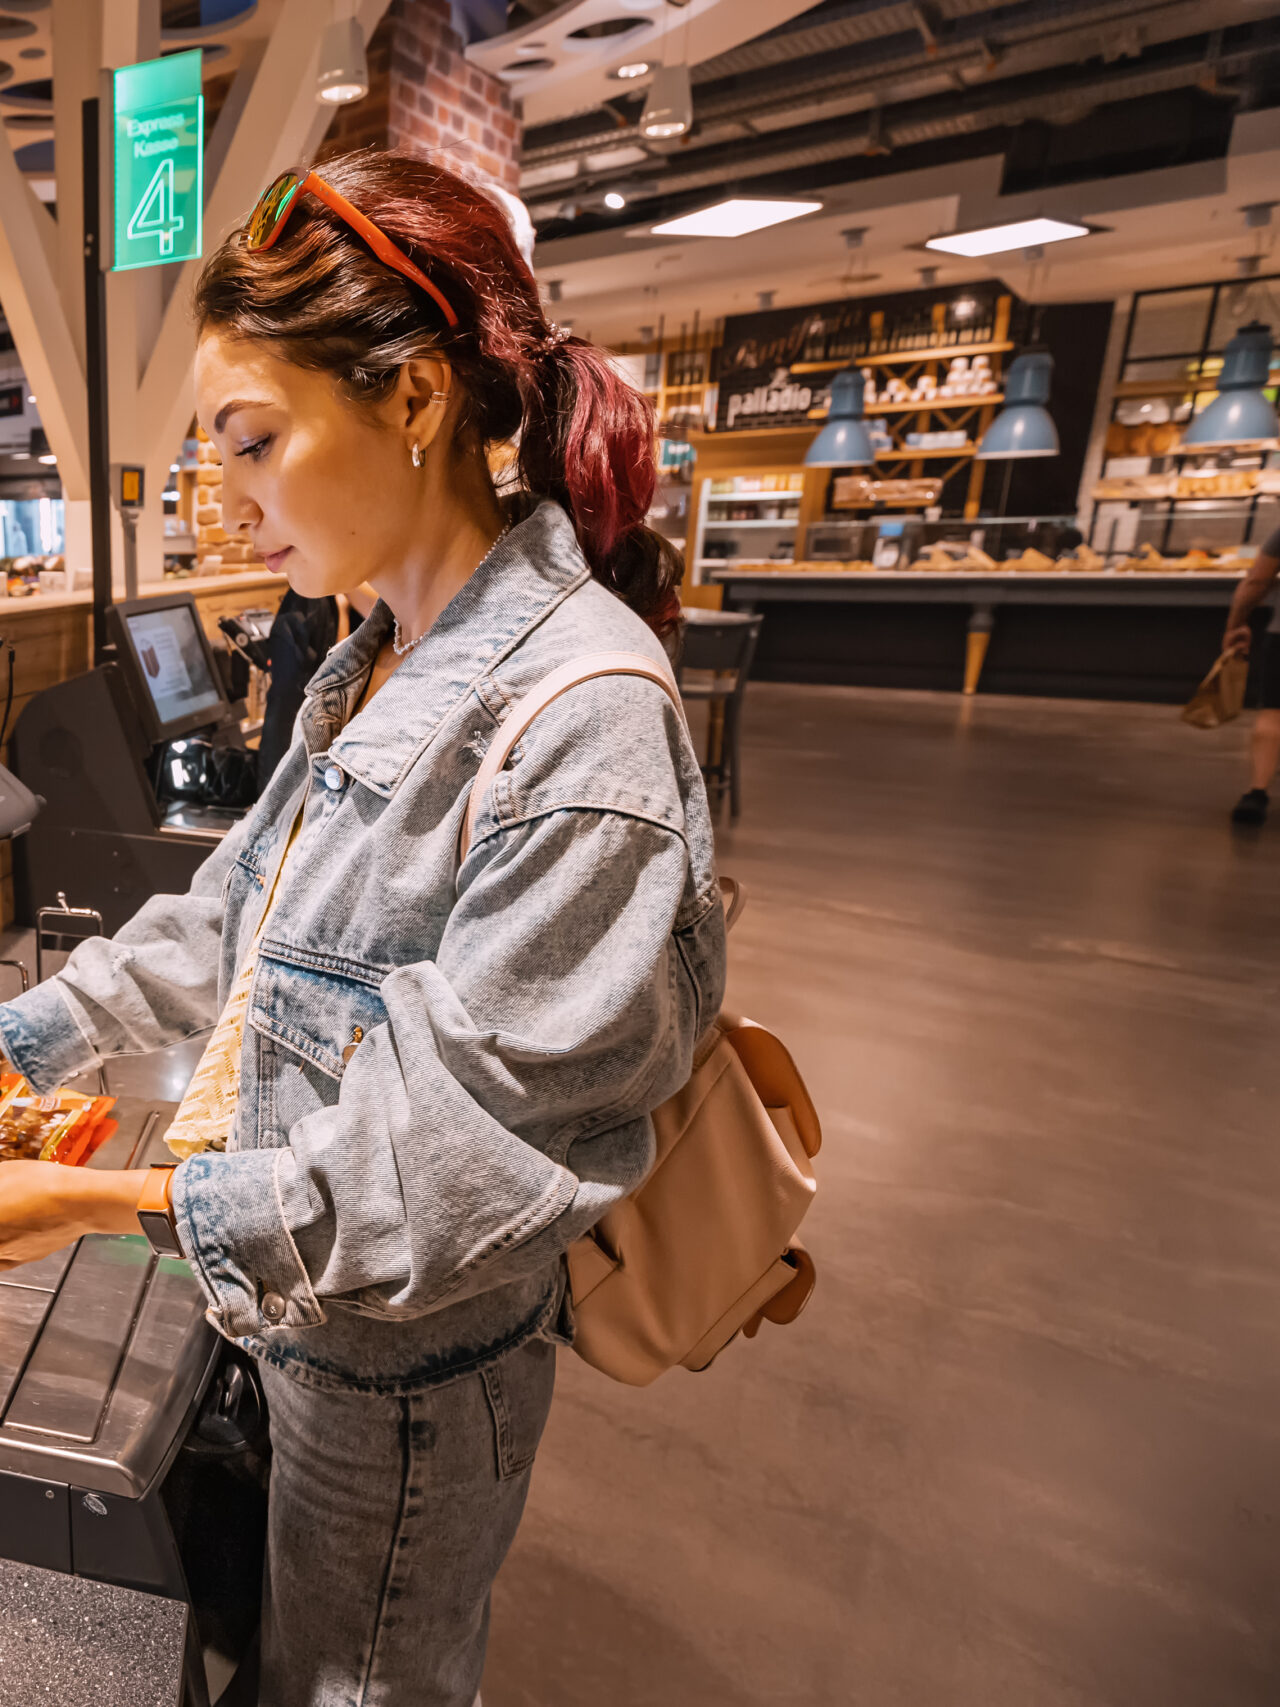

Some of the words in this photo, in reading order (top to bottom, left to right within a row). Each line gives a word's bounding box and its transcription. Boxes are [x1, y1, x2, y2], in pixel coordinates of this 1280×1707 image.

[127, 113, 185, 138] Express
[134, 137, 179, 158] Kasse
[127, 158, 184, 256] 4
[727, 383, 812, 428] palladio
